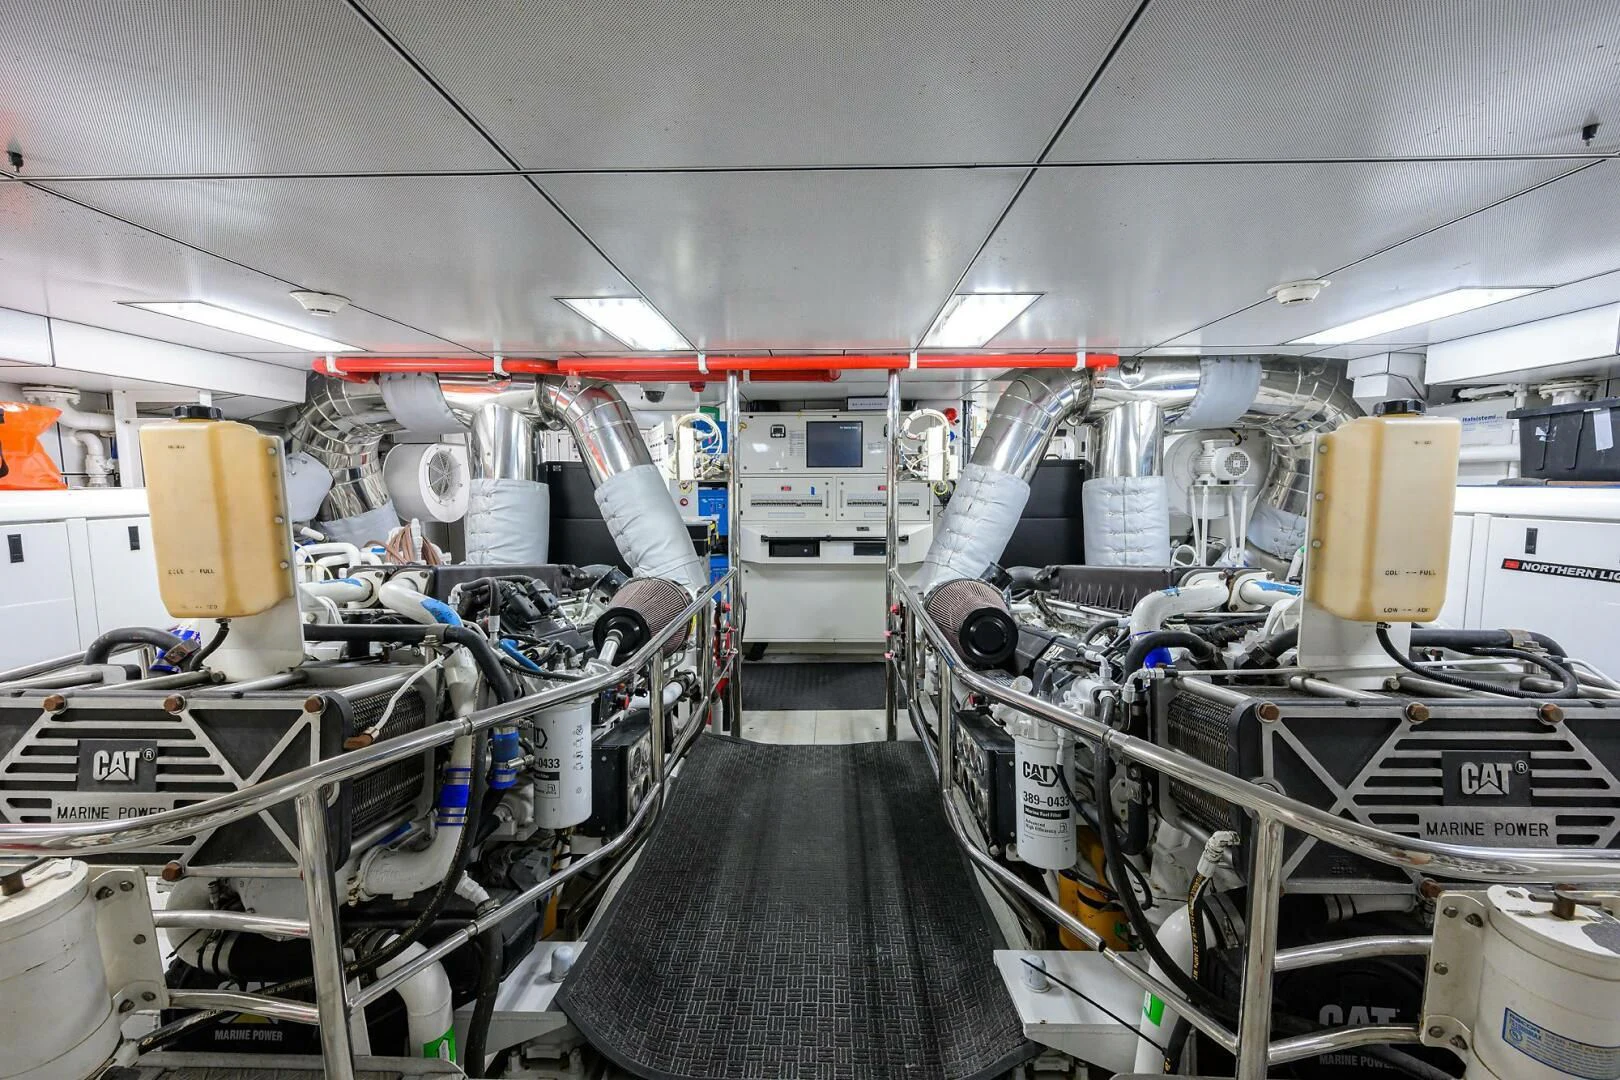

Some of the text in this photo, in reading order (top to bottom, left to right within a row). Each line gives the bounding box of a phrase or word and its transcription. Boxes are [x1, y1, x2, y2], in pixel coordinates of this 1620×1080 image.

[1521, 562, 1597, 579] NORTHERN
[1023, 761, 1049, 782] CAT
[57, 806, 110, 820] MARINE
[1426, 822, 1549, 837] MARINE POWER
[214, 1029, 284, 1042] MARINE POWER
[1319, 1054, 1359, 1067] MARINE
